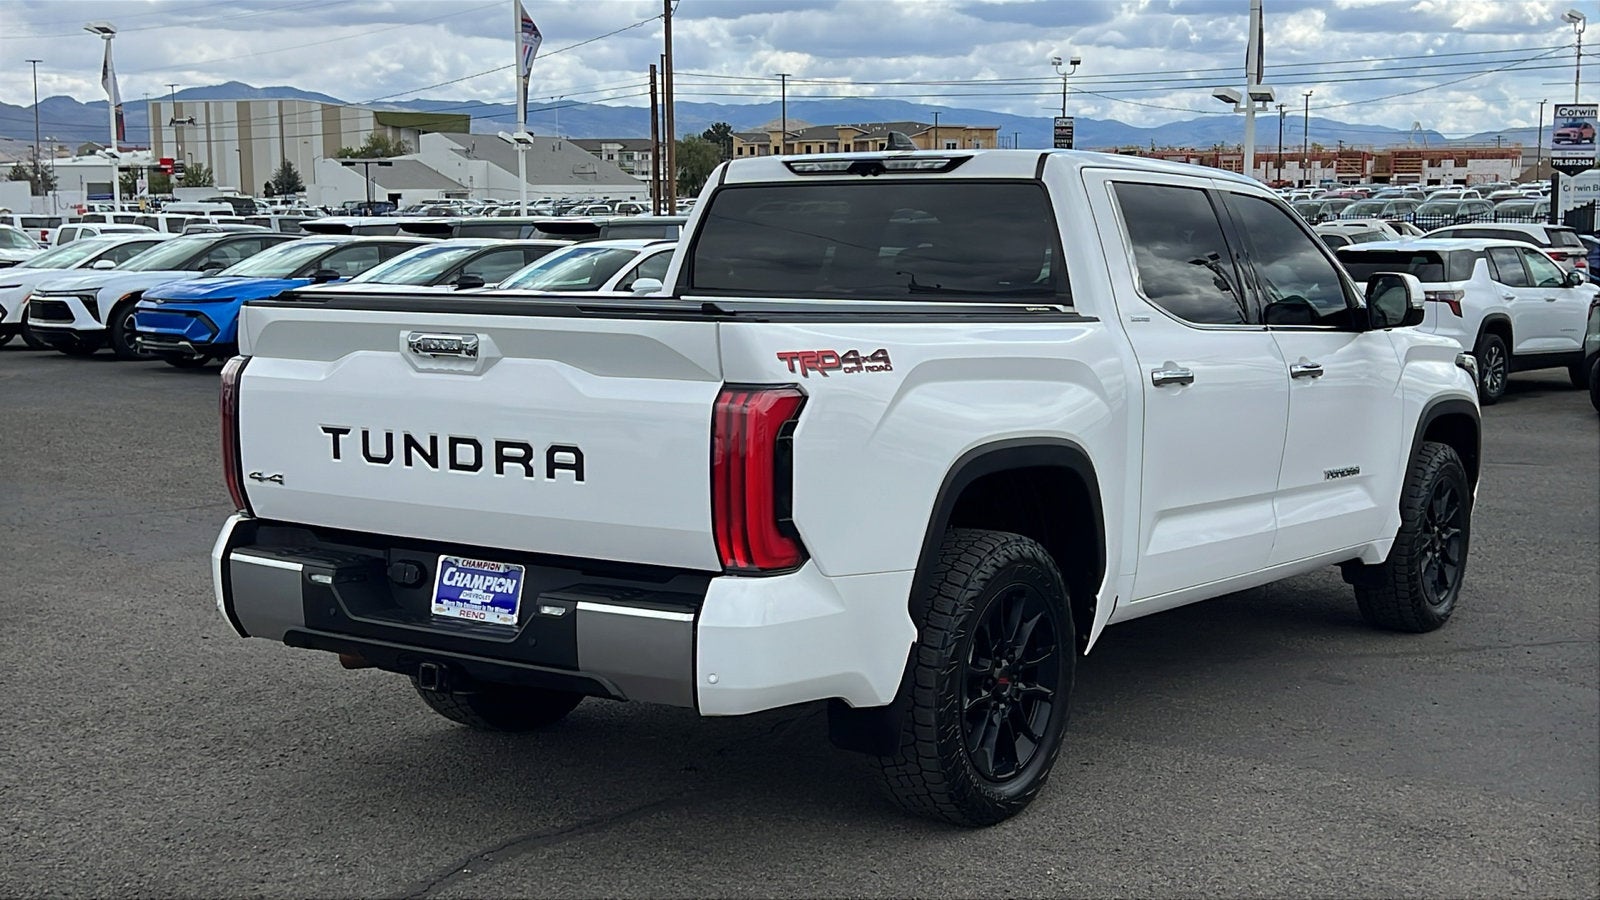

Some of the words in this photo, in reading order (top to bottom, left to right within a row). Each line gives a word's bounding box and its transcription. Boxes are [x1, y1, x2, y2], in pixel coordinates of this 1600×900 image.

[1559, 107, 1597, 117] Corwin
[776, 350, 842, 378] TRD
[843, 366, 864, 374] OFF
[865, 364, 893, 373] ROAD
[319, 424, 585, 483] TUNDRA
[462, 559, 502, 571] CHAMPION
[443, 566, 517, 595] CHAMPION
[462, 591, 492, 601] CHEVROLET
[459, 609, 486, 620] RENO
